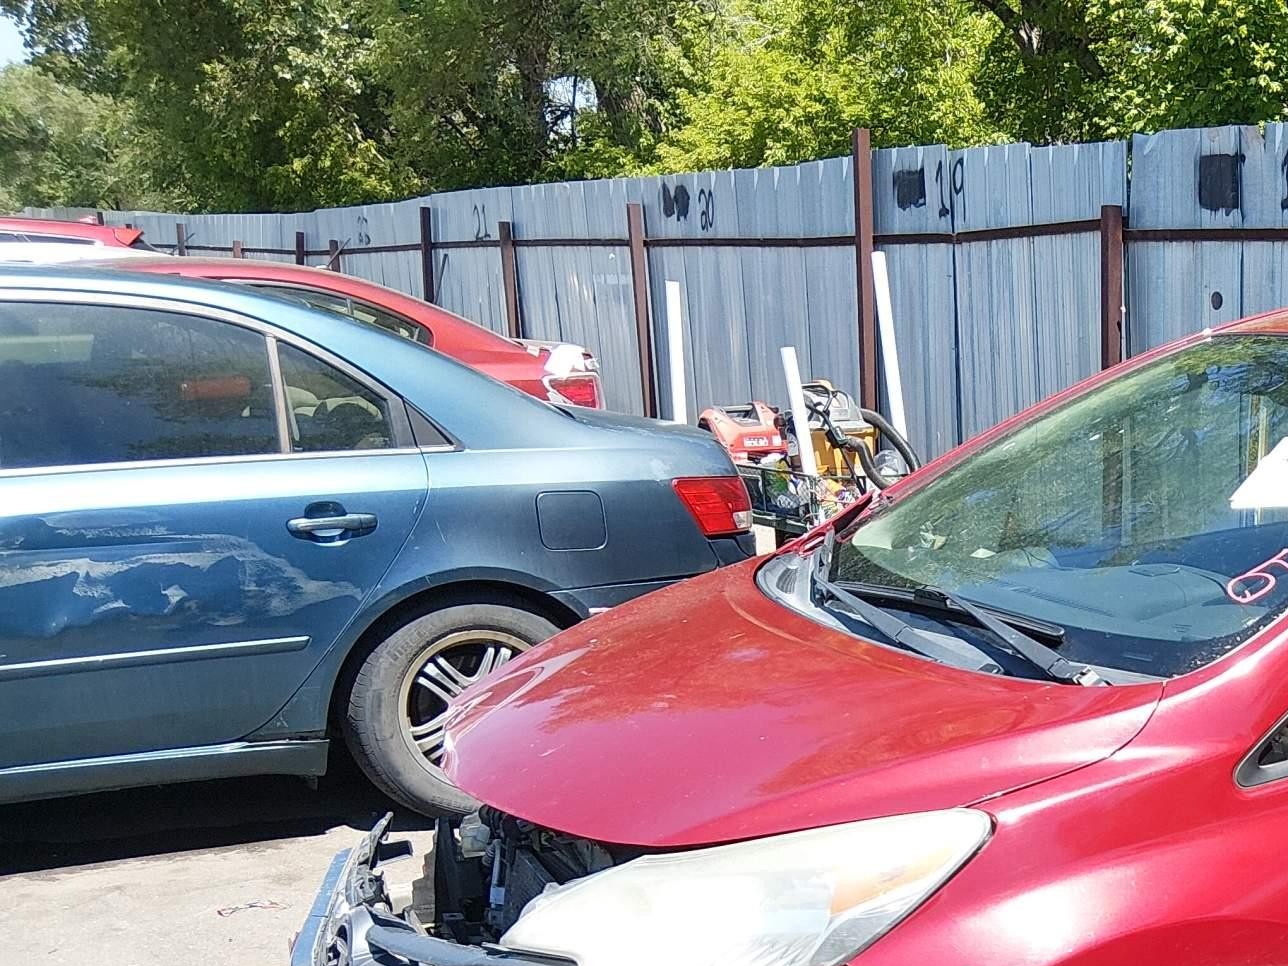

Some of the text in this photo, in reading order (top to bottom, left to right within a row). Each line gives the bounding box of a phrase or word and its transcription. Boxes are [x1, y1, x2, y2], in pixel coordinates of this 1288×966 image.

[698, 188, 715, 232] 20
[935, 157, 966, 223] 19
[473, 203, 491, 240] 21
